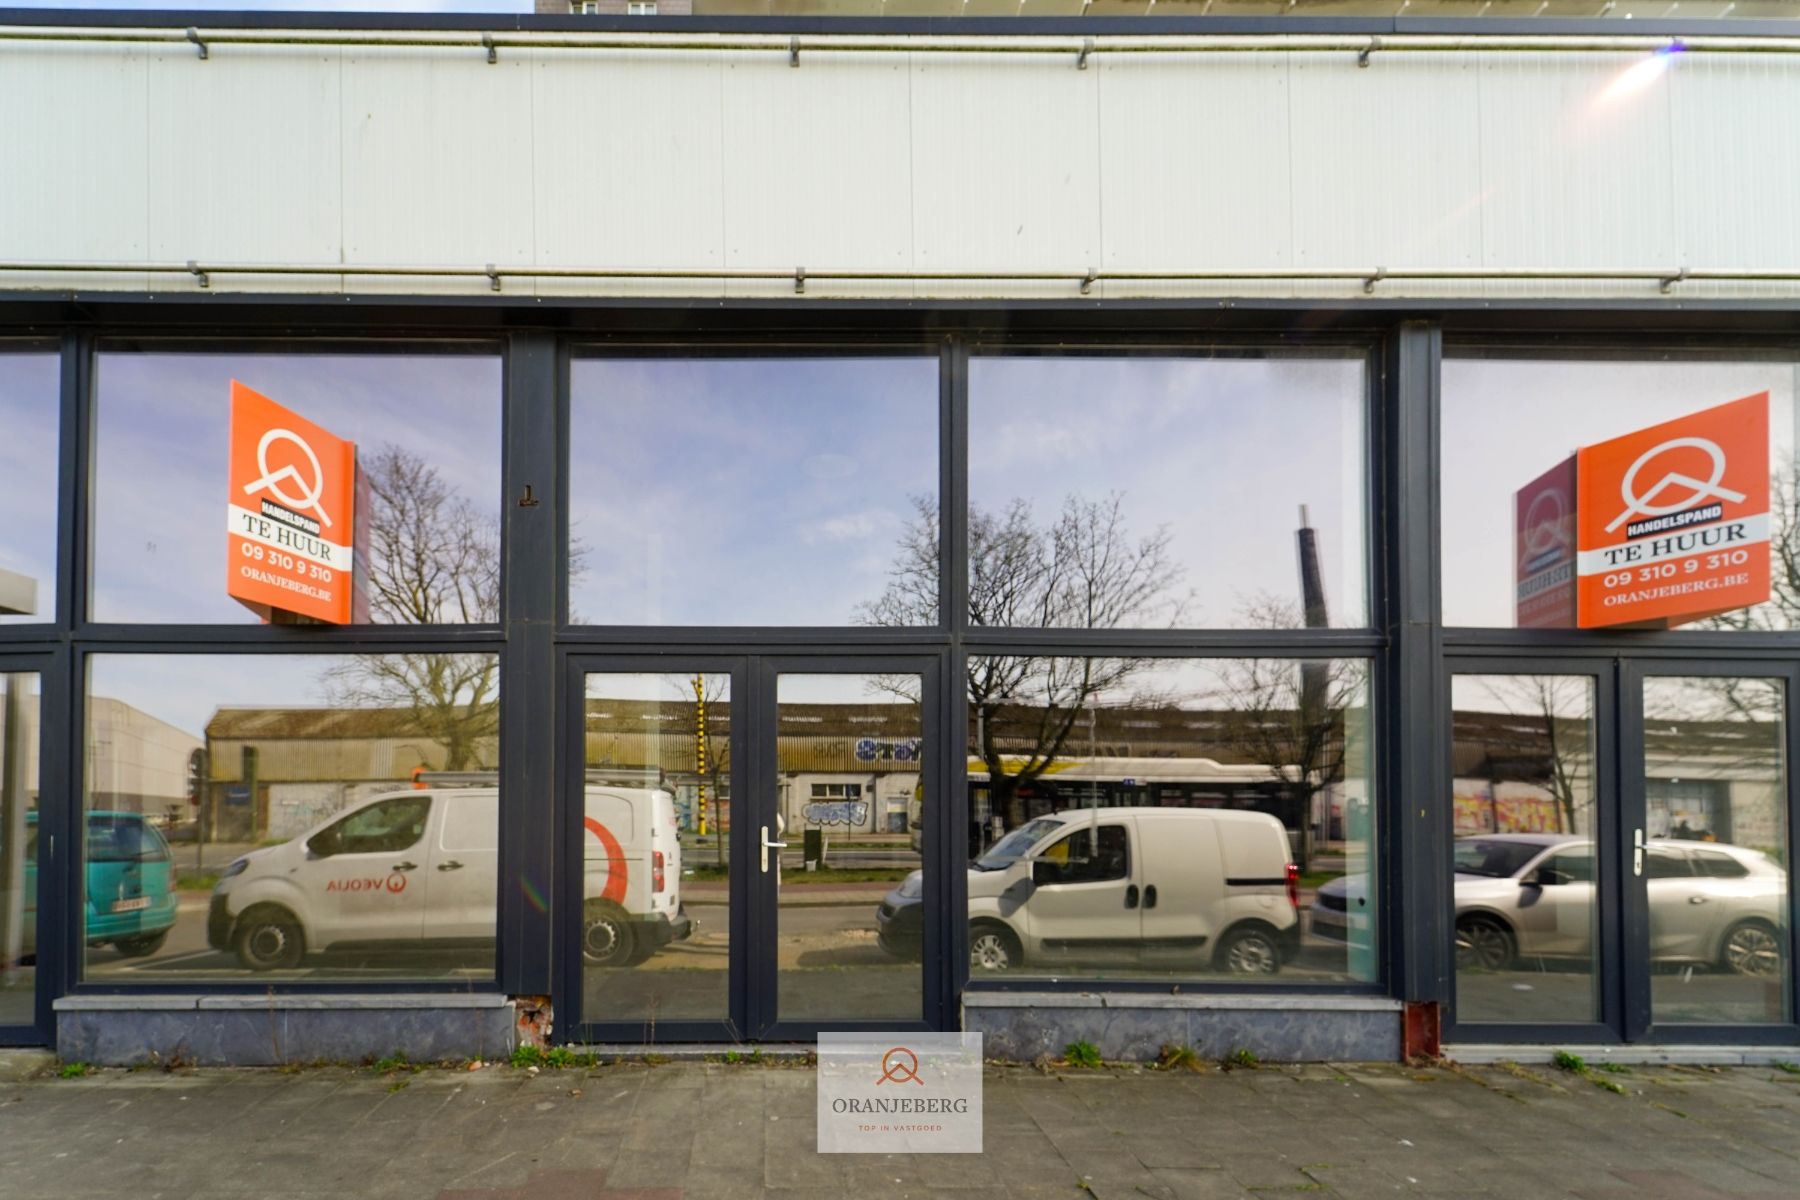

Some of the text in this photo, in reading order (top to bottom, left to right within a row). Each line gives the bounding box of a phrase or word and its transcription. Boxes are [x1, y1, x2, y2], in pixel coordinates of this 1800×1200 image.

[243, 513, 331, 560] TE HUUR
[1628, 506, 1721, 536] HANDELSPAND
[241, 542, 332, 583] 09 310 9 310
[1604, 523, 1747, 565] TE HUUR
[241, 565, 331, 601] ORANJEBERG.BE
[1604, 550, 1748, 588] 09 310 9 310
[1604, 573, 1748, 606] ORANJEBERG.BE
